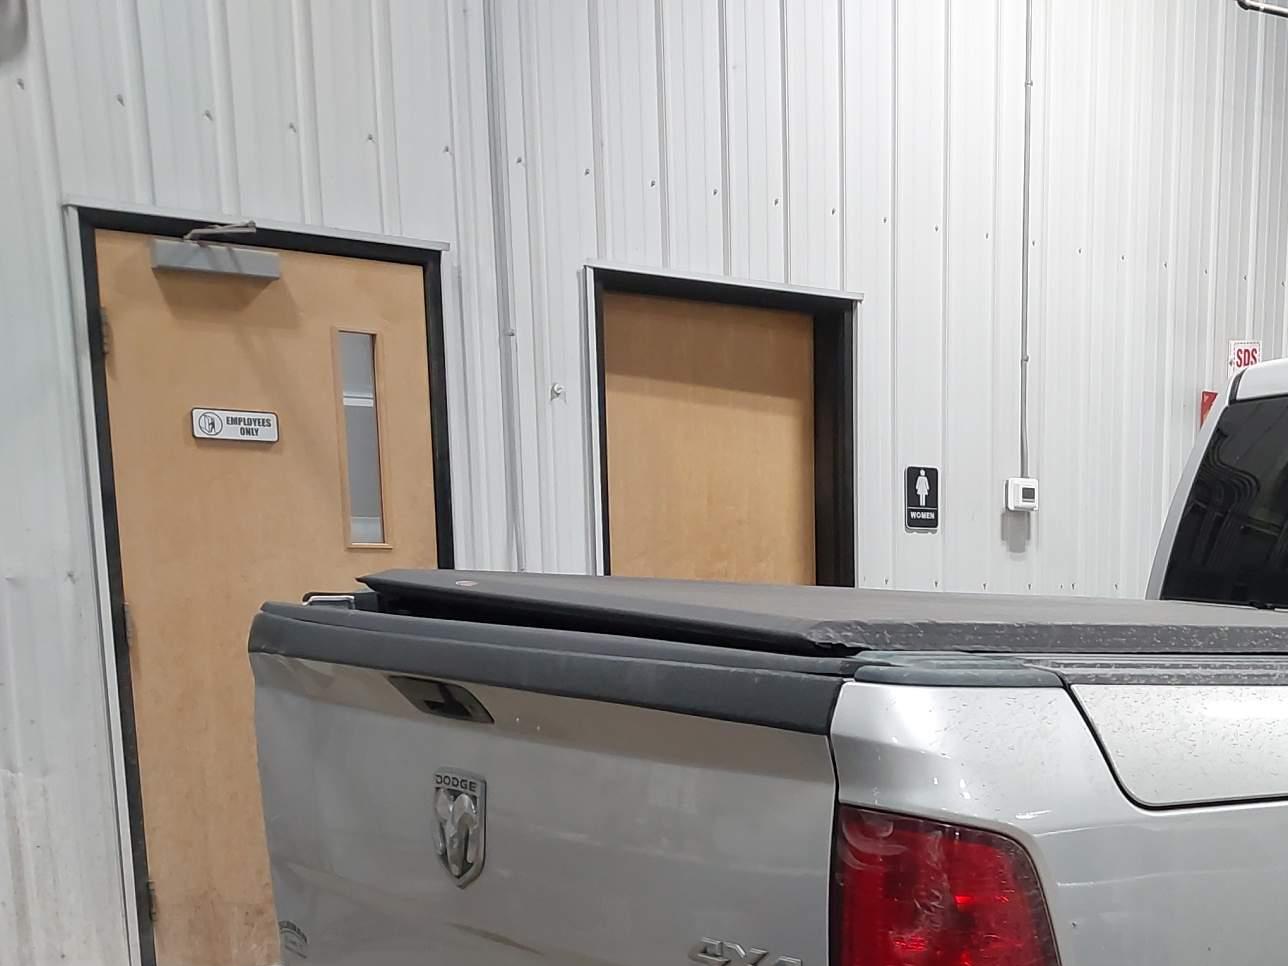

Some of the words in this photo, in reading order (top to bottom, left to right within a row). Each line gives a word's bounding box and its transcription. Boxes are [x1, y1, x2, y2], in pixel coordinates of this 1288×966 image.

[1235, 347, 1258, 368] SDS
[226, 414, 272, 428] EMPLOYEES
[240, 427, 260, 437] ONLY
[910, 511, 935, 520] WOMEN
[434, 774, 478, 793] DODGE
